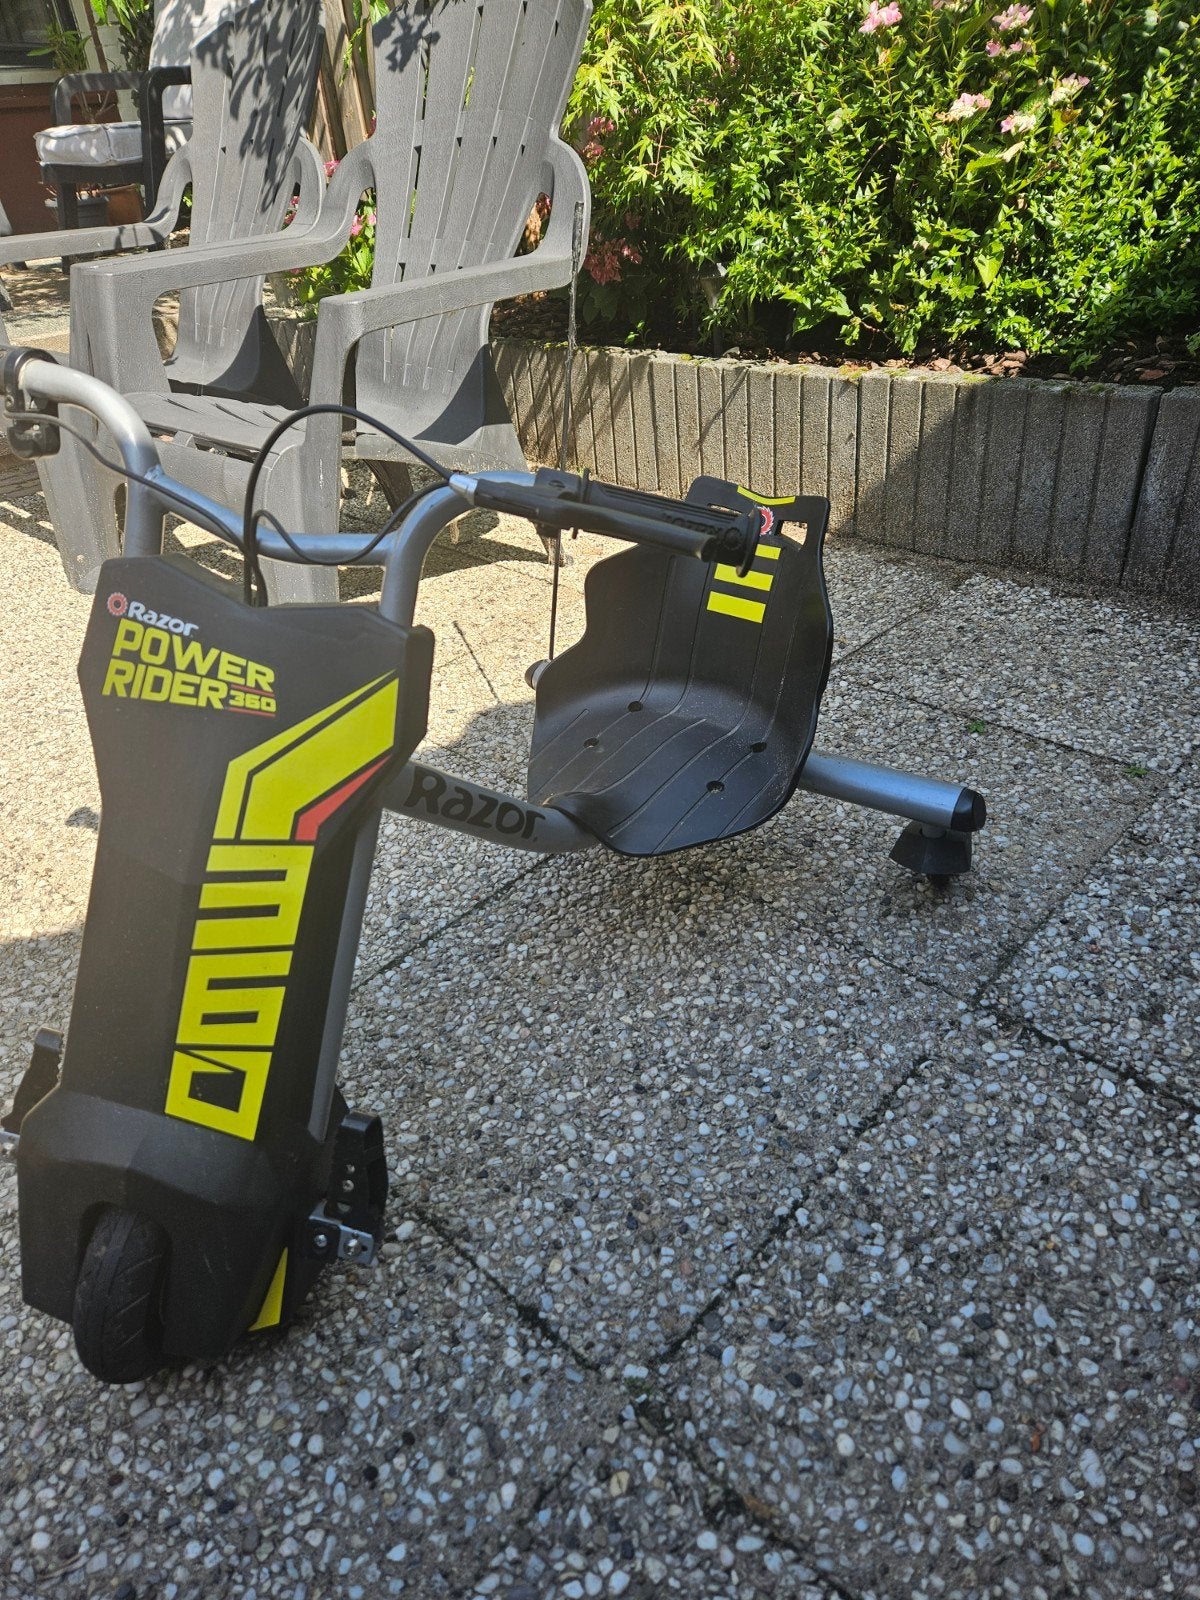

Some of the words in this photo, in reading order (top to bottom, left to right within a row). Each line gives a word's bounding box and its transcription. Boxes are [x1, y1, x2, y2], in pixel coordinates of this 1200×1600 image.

[127, 601, 199, 637] Razor
[102, 658, 228, 710] RIDER
[228, 691, 277, 713] 360
[112, 618, 275, 692] POWER
[403, 766, 546, 840] Razor
